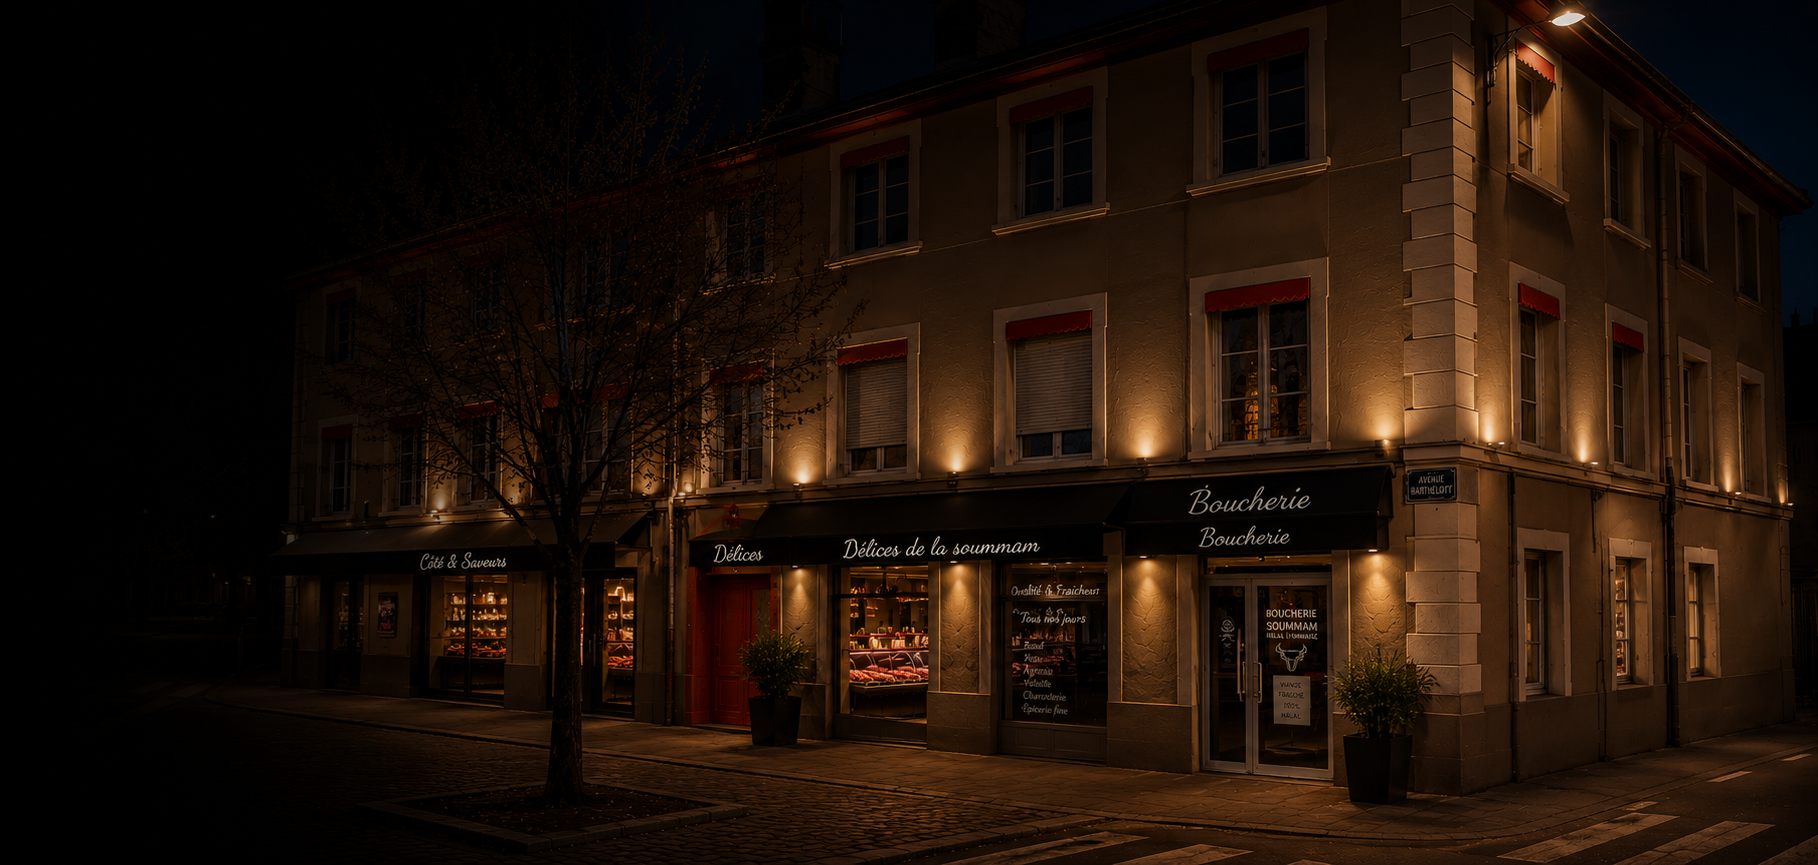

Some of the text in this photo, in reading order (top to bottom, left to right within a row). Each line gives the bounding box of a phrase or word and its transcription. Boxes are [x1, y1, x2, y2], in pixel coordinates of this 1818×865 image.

[1188, 484, 1311, 516] Boucherie
[1198, 525, 1291, 548] Boucherie
[713, 543, 764, 563] Délices
[842, 535, 1040, 560] Délices de la soummam
[447, 553, 458, 569] &
[461, 551, 507, 570] Saveurs
[1266, 608, 1317, 618] BOUCHERIE
[1266, 621, 1318, 631] SOUMMAM
